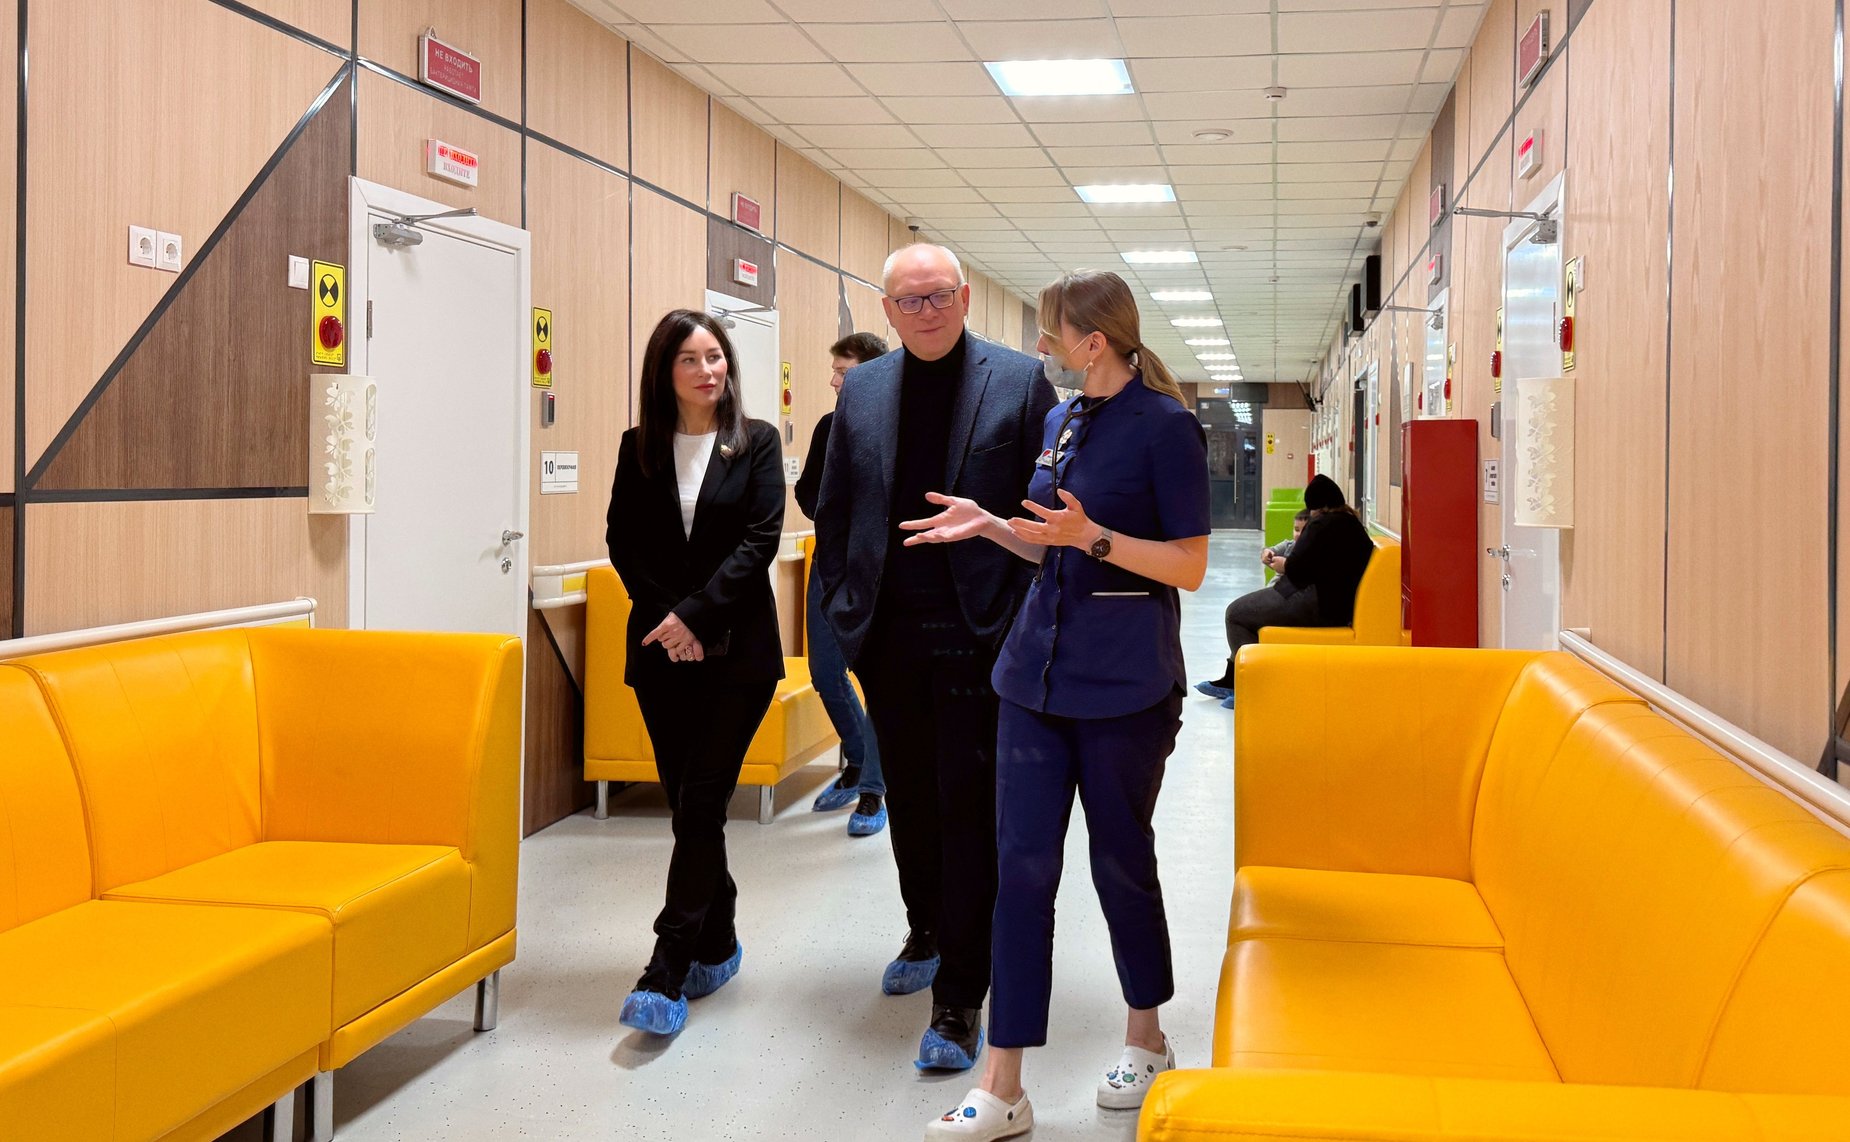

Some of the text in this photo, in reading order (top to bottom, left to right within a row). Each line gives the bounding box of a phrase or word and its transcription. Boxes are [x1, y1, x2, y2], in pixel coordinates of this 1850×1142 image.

[435, 48, 473, 73] НЕ ВХОДИТЬ
[544, 460, 554, 475] 10
